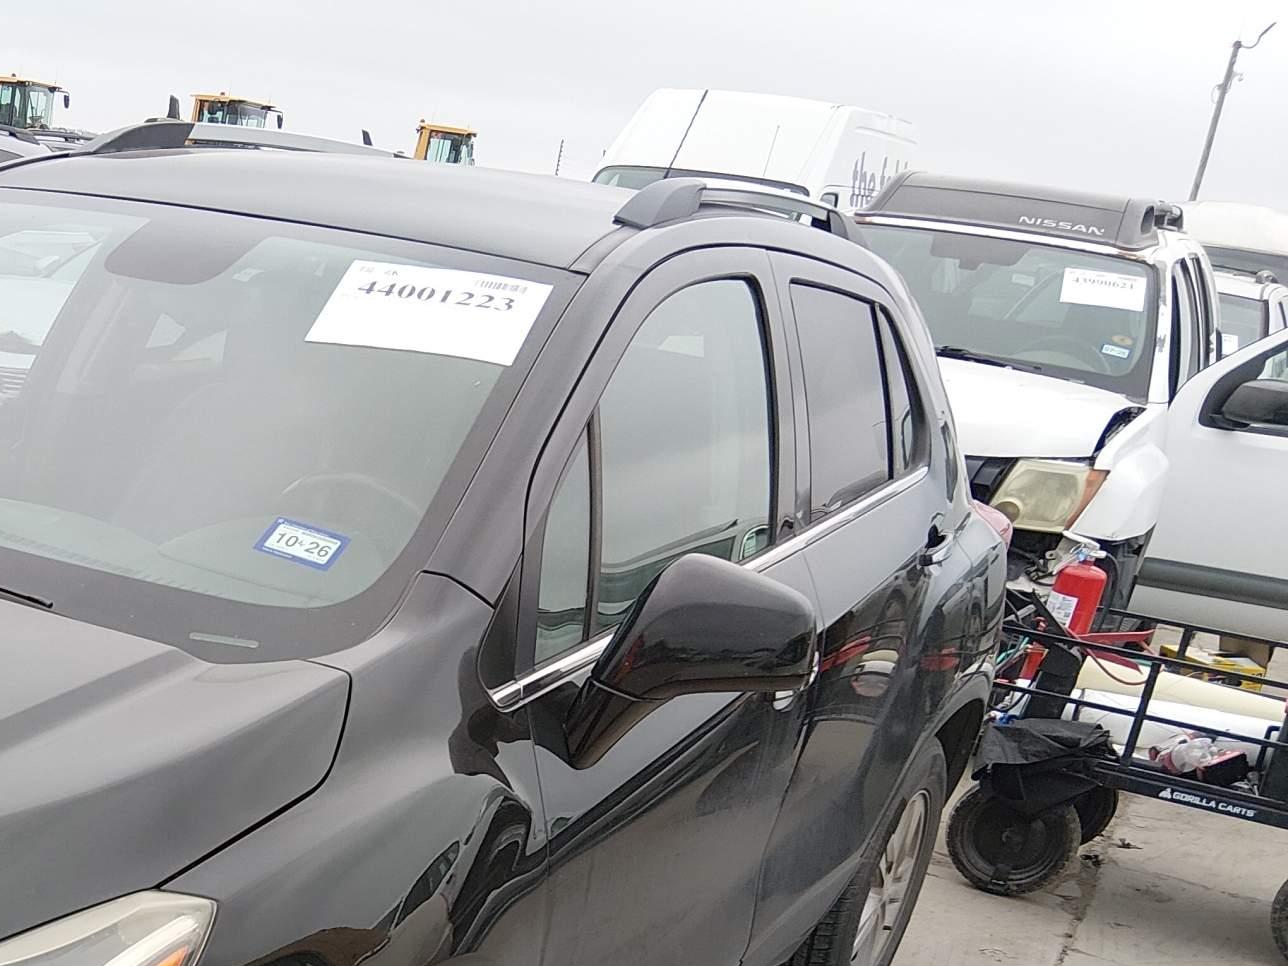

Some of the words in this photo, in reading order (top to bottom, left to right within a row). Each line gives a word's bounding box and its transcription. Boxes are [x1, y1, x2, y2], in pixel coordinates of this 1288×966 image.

[1018, 215, 1105, 236] NISSAN
[358, 280, 516, 312] 44001223
[1172, 791, 1216, 808] GORILLA
[1218, 803, 1257, 817] CARTS
